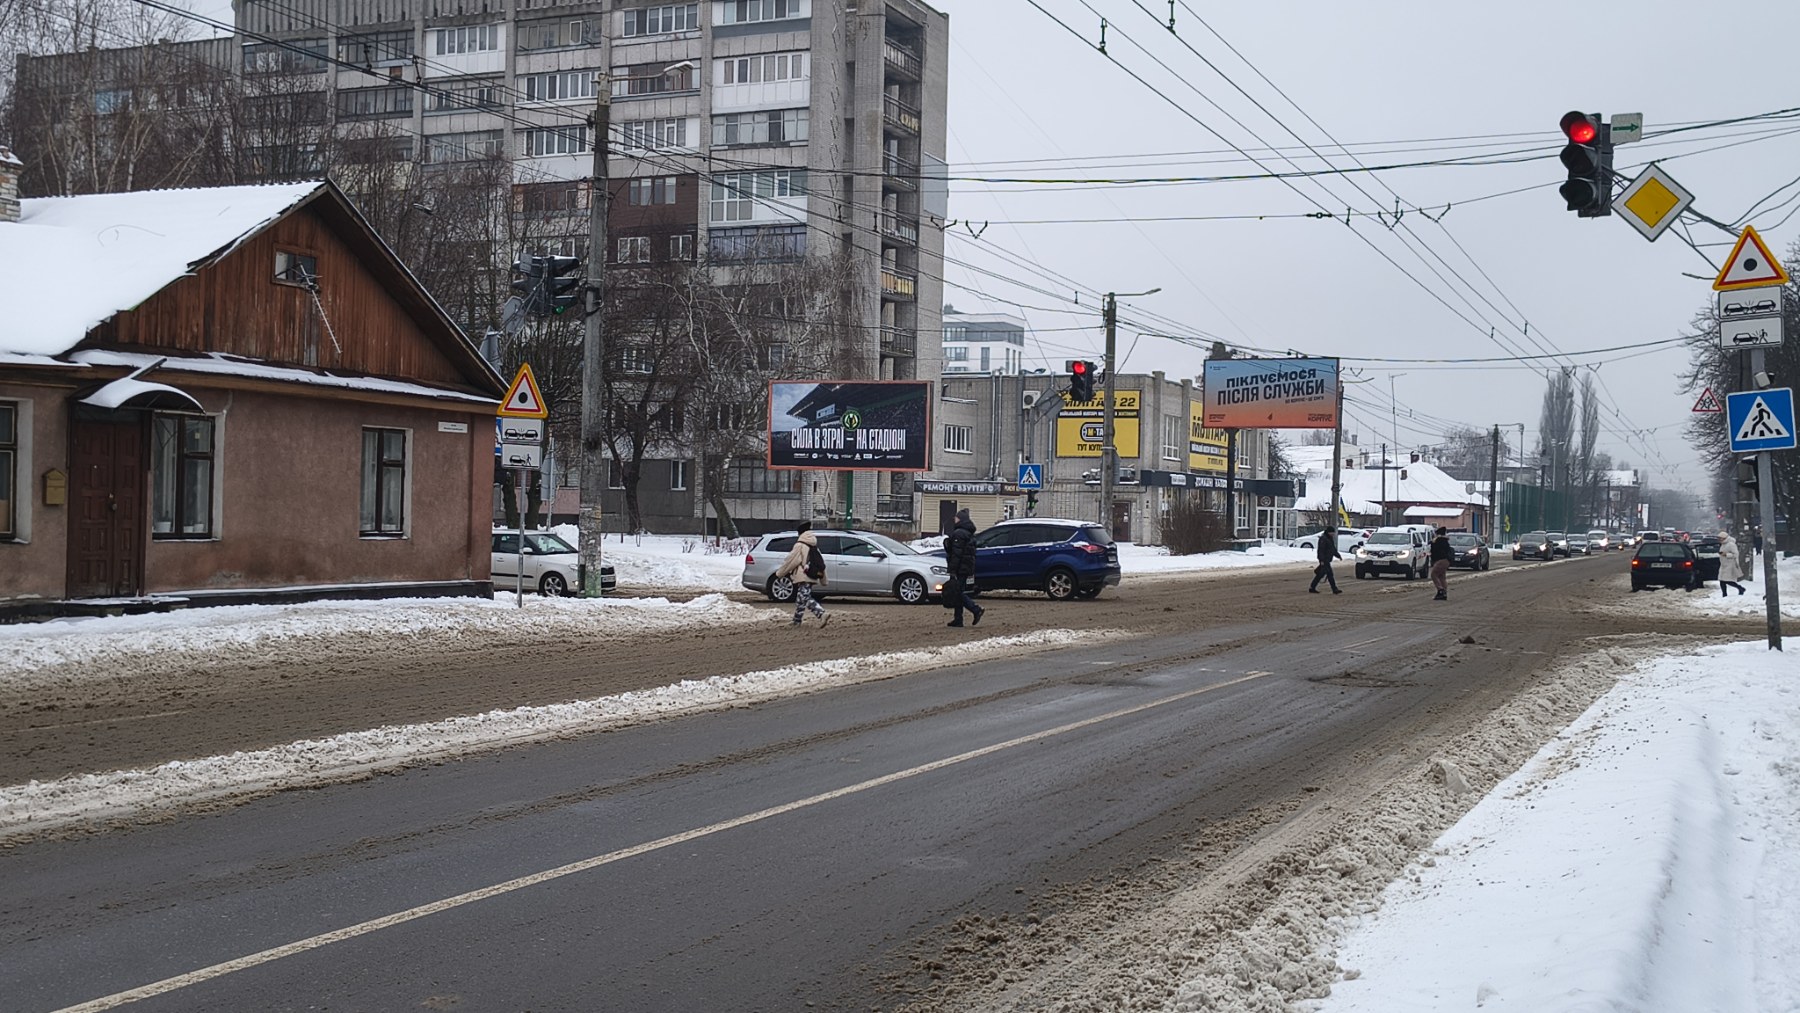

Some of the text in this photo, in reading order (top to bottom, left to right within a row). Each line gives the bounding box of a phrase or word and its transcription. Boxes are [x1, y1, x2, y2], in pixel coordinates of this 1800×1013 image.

[1226, 368, 1317, 388] ПІКЛУЄМОСЯ
[1119, 398, 1136, 407] 22
[1217, 379, 1325, 406] ПІСЛЯ СЛУЖБИ
[791, 428, 813, 449] СИЛА
[814, 428, 820, 449] В
[822, 427, 845, 449] ЗГРАЇ
[856, 428, 868, 450] НА
[869, 428, 906, 451] СТАДІОНІ
[922, 483, 985, 493] РЕМОНТ ВЗУТТЯ
